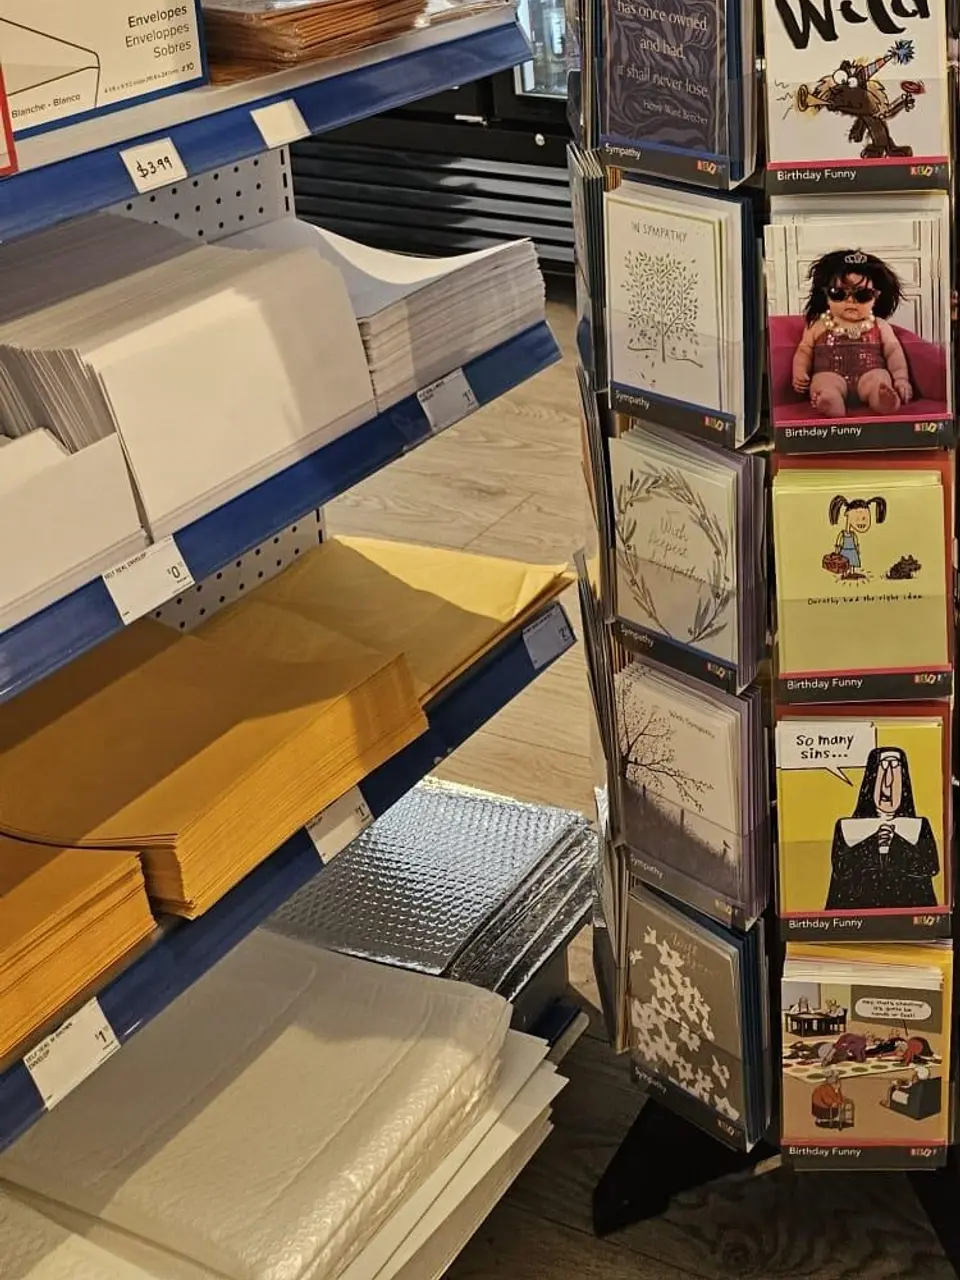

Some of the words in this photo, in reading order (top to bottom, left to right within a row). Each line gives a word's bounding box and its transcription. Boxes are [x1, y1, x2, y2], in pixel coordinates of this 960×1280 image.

[128, 5, 188, 29] Envelopes
[639, 6, 666, 22] once
[668, 10, 707, 31] owned
[125, 23, 190, 49] Enveloppes
[640, 36, 660, 51] and
[153, 40, 192, 59] Sobres
[626, 64, 650, 81] shall
[652, 74, 683, 91] never
[11, 102, 46, 119] Blanche
[53, 93, 81, 107] Blanco
[605, 143, 641, 161] Sympathy
[136, 155, 173, 179] $3.99
[777, 171, 822, 182] Birthday
[824, 170, 857, 182] Funny
[643, 224, 688, 242] SYMPATHY
[616, 390, 650, 410] Sympathy
[785, 427, 828, 439] Birthday
[830, 426, 862, 439] Funny
[808, 596, 839, 606] Dorothy
[863, 595, 876, 603] the
[878, 593, 900, 604] right
[620, 624, 655, 648] Sympathy
[787, 679, 829, 690] Birthday
[832, 677, 863, 690] Funny
[796, 734, 814, 747] So
[818, 734, 854, 750] many
[801, 748, 848, 760] sins...
[630, 853, 664, 879] Sympathy
[789, 919, 830, 930] Birthday
[833, 918, 863, 930] Funny
[635, 1065, 668, 1094] Sympathy
[789, 1146, 831, 1157] Birthday
[832, 1147, 862, 1158] Funny
